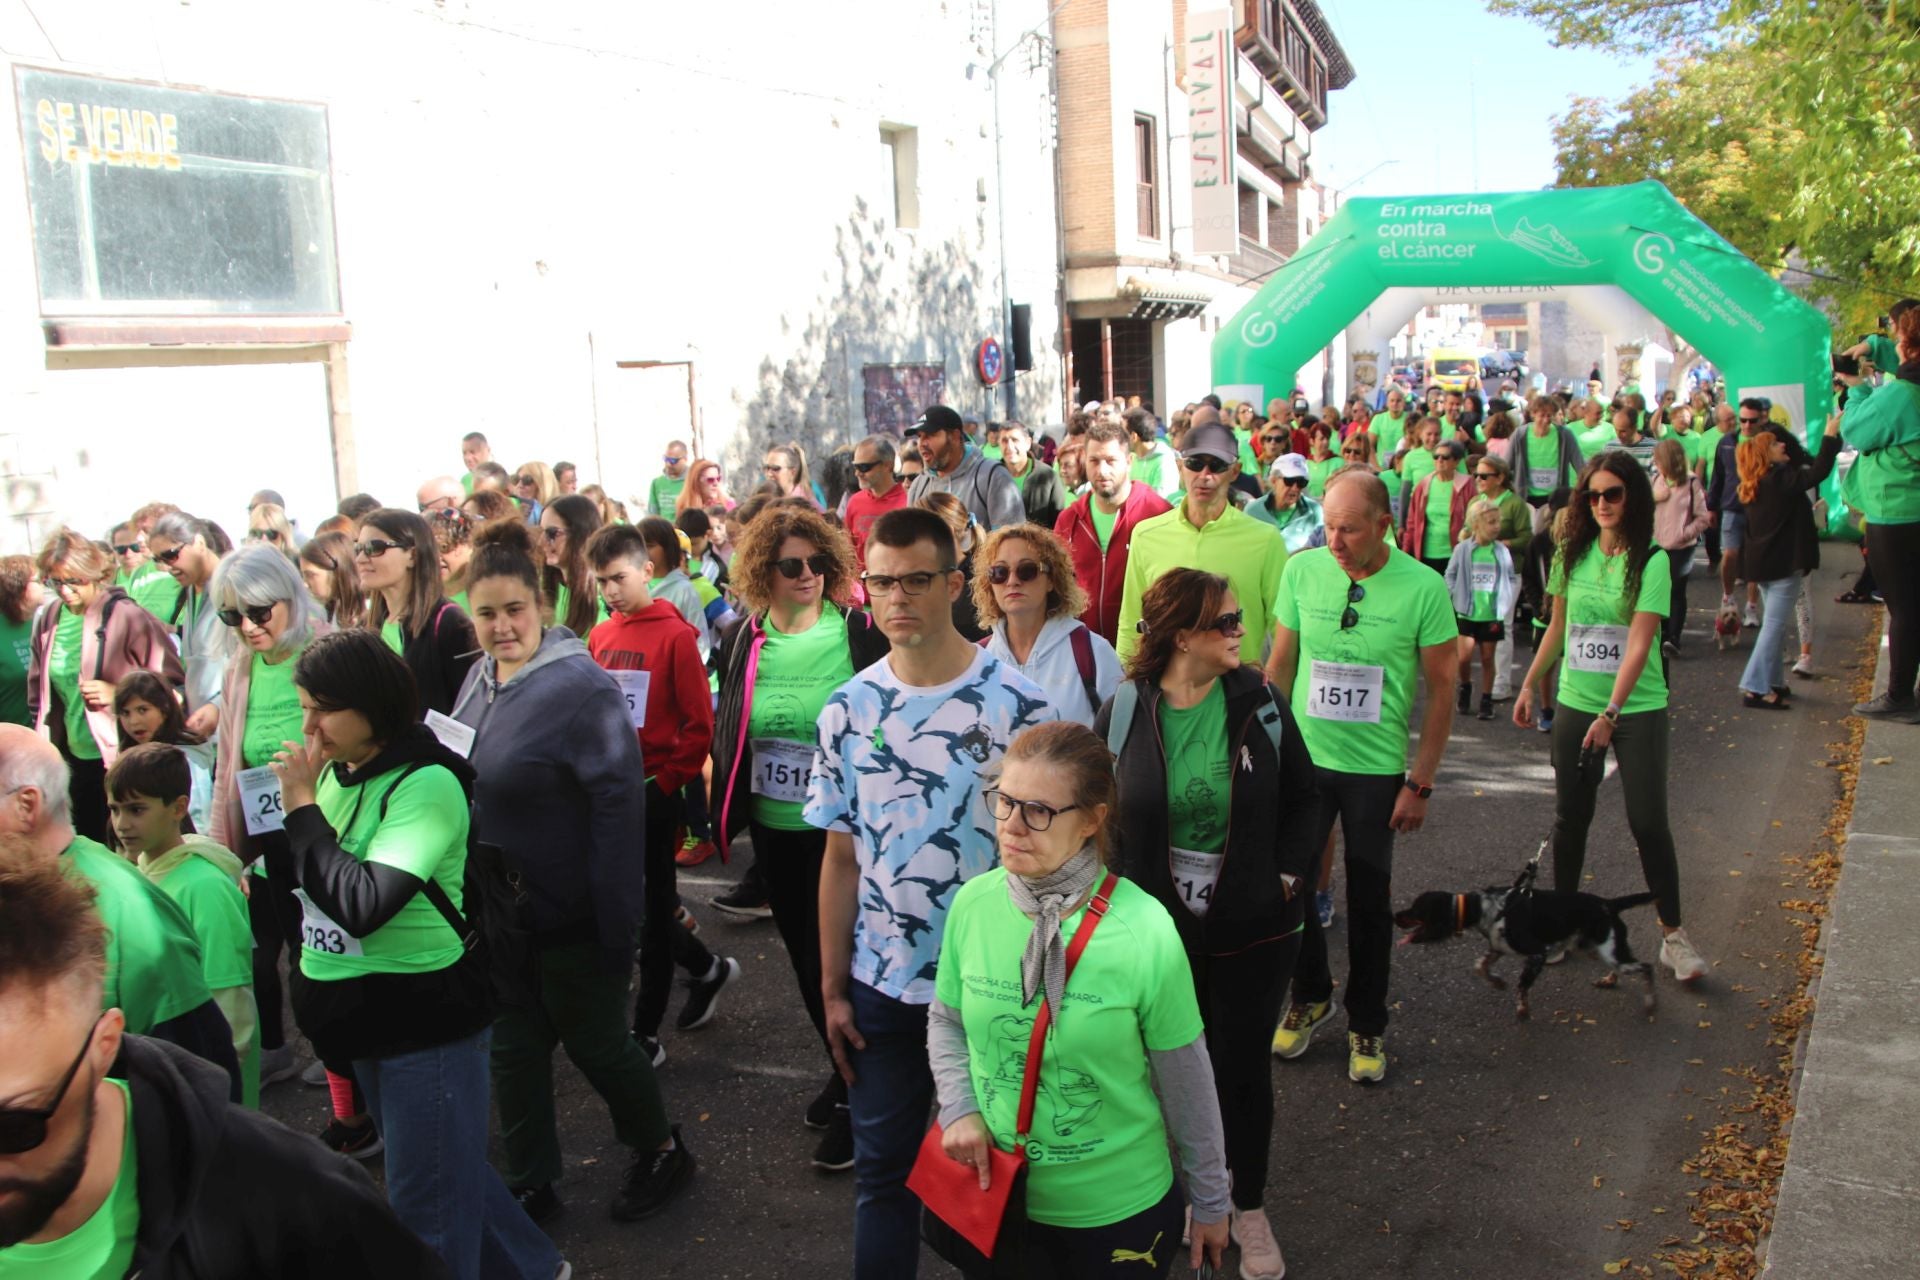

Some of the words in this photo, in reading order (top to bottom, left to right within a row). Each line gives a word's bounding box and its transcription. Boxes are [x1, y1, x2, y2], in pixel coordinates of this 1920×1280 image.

[37, 98, 76, 163] SE
[80, 103, 182, 172] VENDE
[1381, 203, 1406, 217] En
[1412, 201, 1492, 217] marcha
[1378, 219, 1446, 237] contra
[1378, 240, 1399, 258] el
[1403, 240, 1477, 258] cáncer
[1670, 268, 1699, 294] contra
[1707, 300, 1739, 327] cáncer
[1675, 287, 1712, 322] Segovia
[1680, 259, 1725, 299] asociación
[1724, 297, 1765, 333] española
[1577, 642, 1621, 660] 1394
[1318, 686, 1370, 708] 1517
[1062, 991, 1104, 1005] OMARCA
